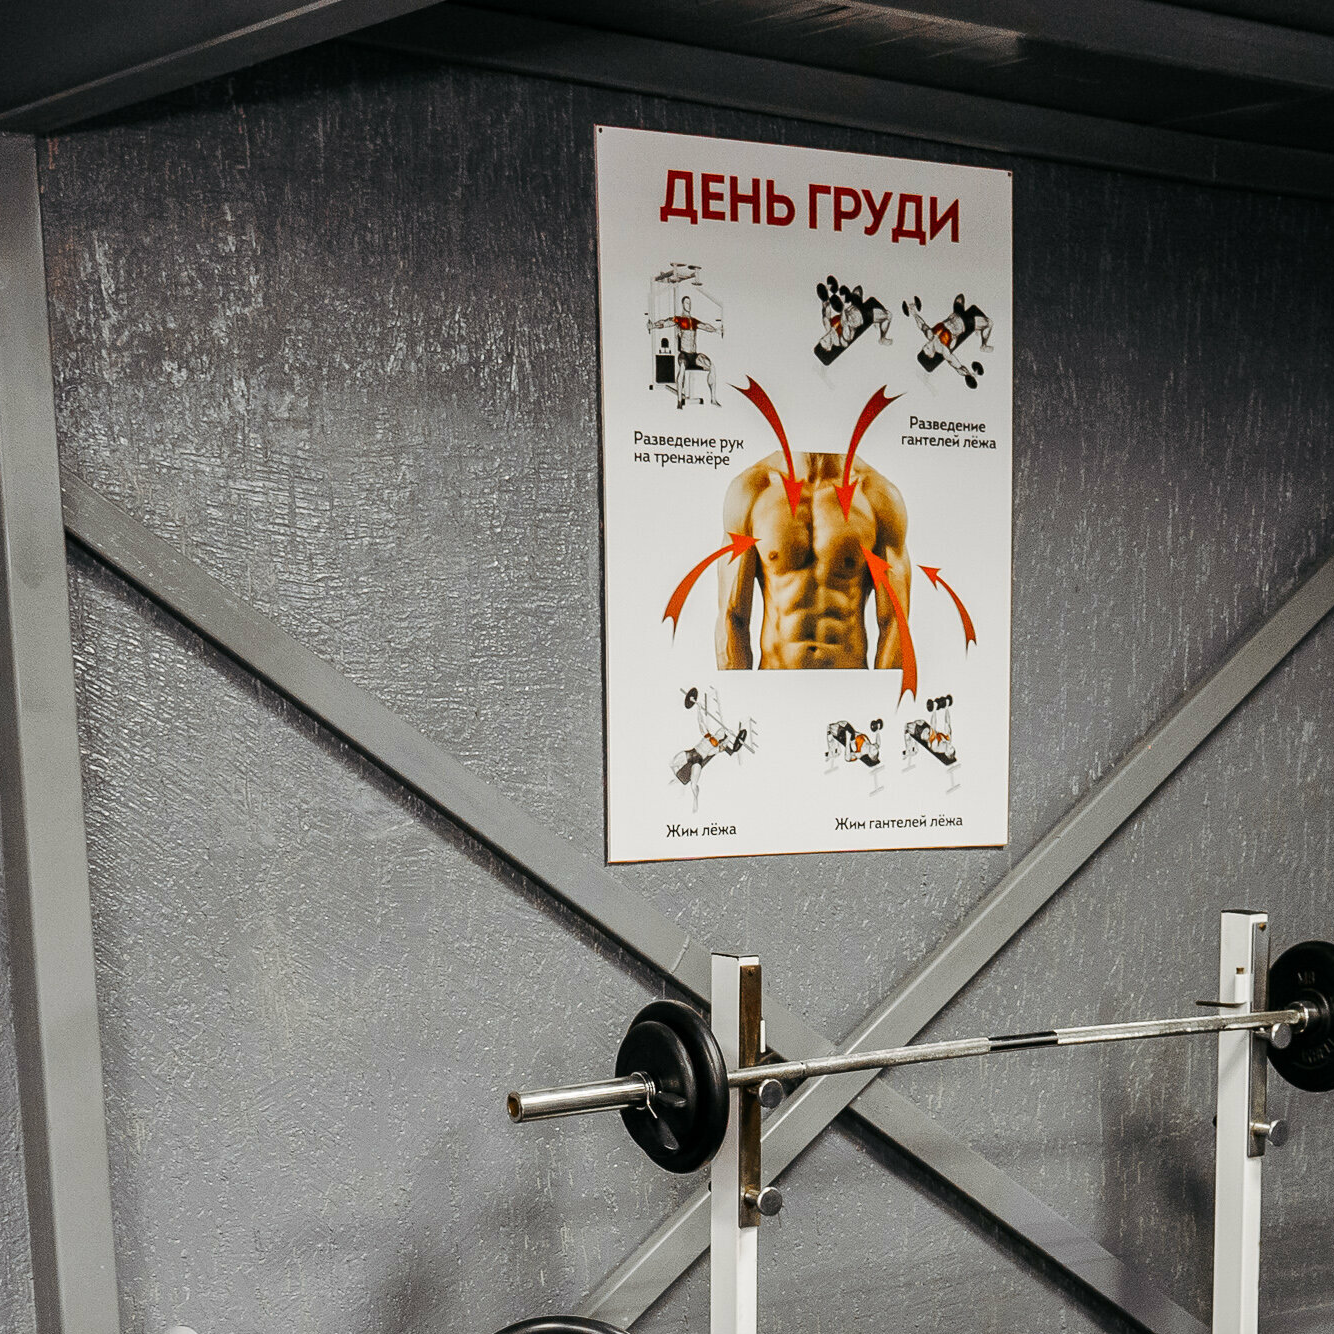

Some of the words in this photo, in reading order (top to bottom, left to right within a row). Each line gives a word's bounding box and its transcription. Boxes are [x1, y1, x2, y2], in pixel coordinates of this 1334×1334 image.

[660, 169, 796, 226] ДЕНЬ
[809, 184, 959, 246] ГРУДИ
[910, 416, 986, 433] Разведение
[634, 431, 716, 448] Разведение
[720, 439, 744, 453] рук
[902, 435, 960, 447] гантелей
[963, 435, 996, 449] лёжа
[634, 452, 650, 462] на
[654, 451, 730, 469] тренажёре
[666, 824, 698, 838] Жим
[702, 823, 737, 836] лёжа
[835, 817, 865, 830] Жим
[869, 815, 926, 829] гантелей
[930, 814, 963, 827] лёжа
